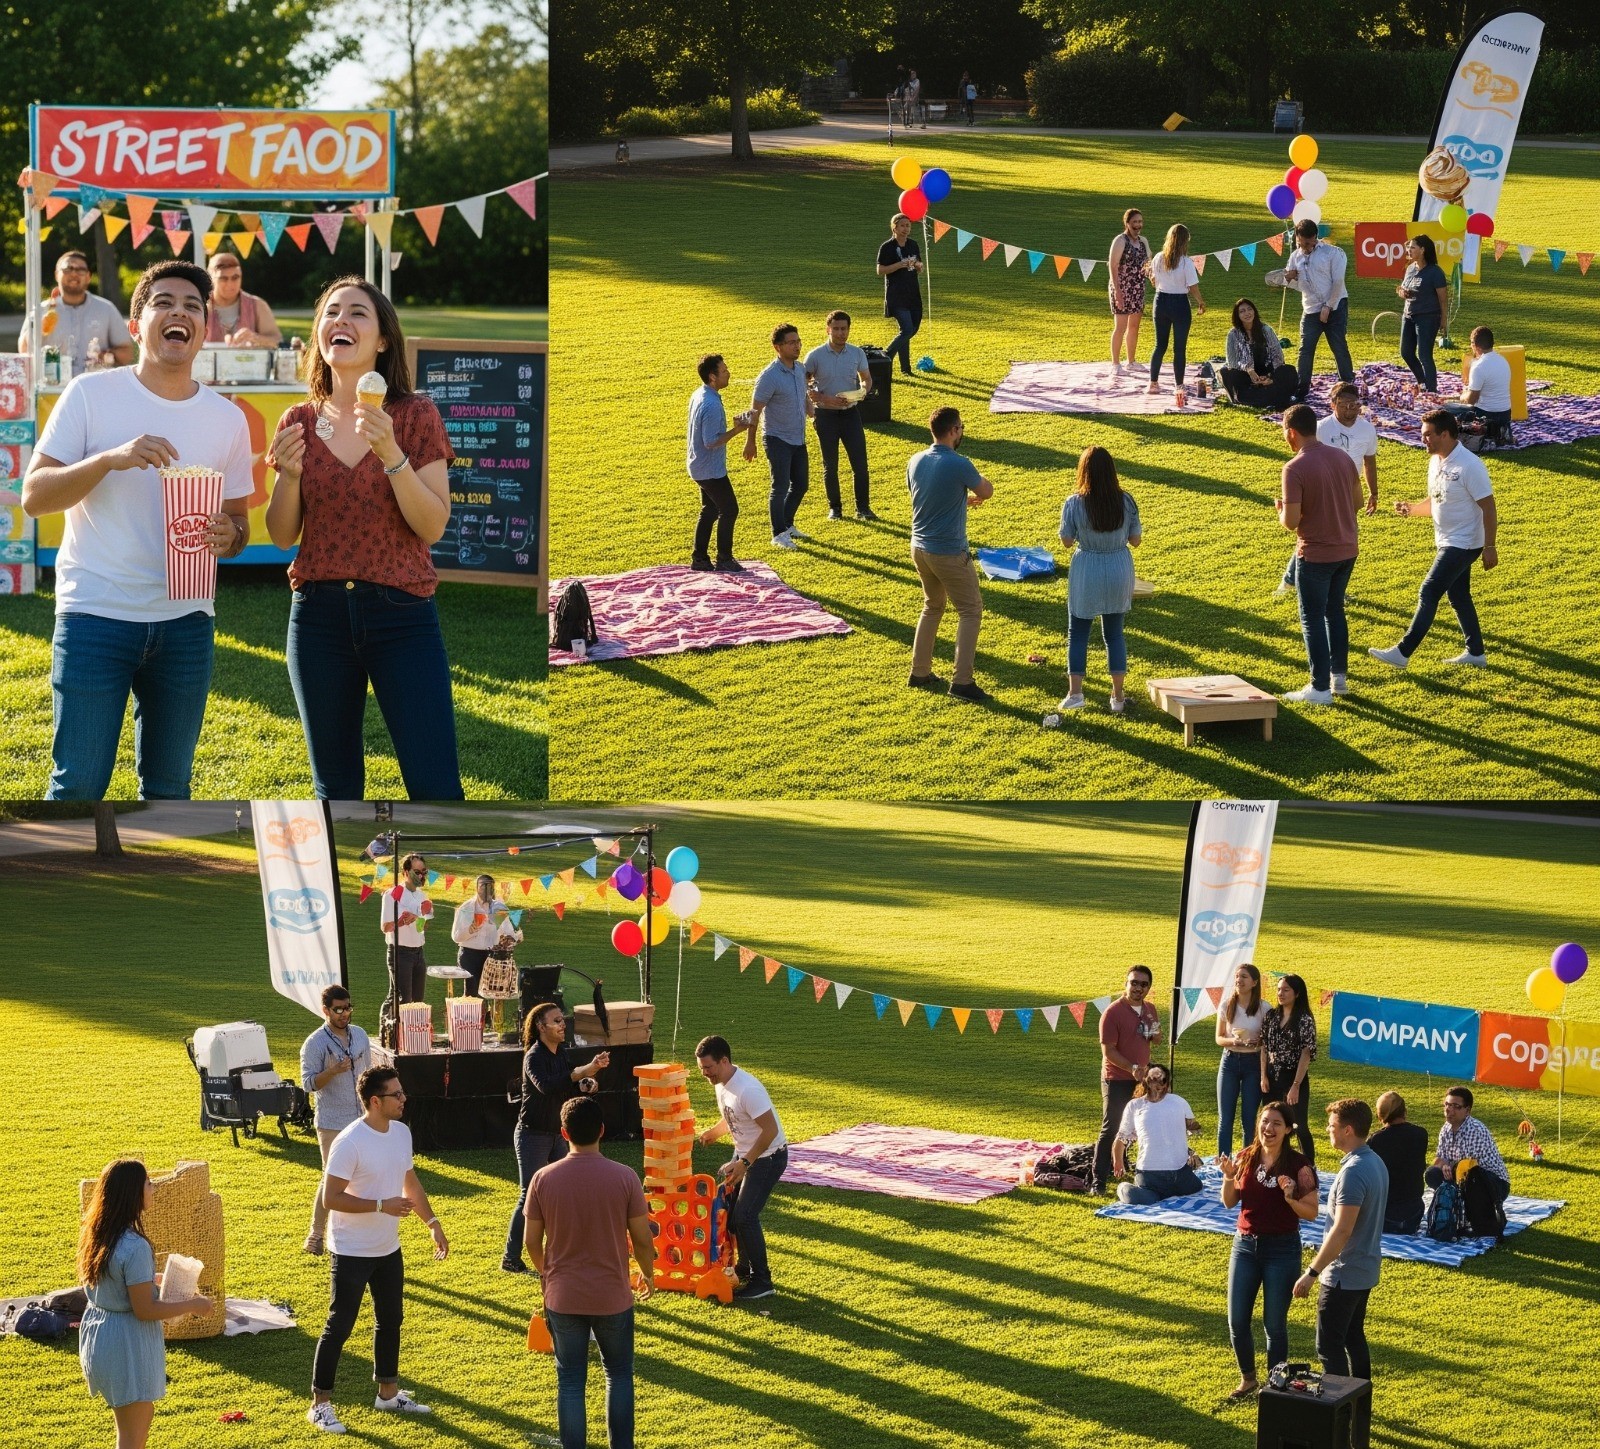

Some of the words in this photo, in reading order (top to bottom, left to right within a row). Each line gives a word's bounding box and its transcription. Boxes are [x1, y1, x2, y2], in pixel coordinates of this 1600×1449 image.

[50, 120, 246, 177] STREET
[250, 123, 383, 179] FAOD
[1341, 1015, 1467, 1054] COMPANY
